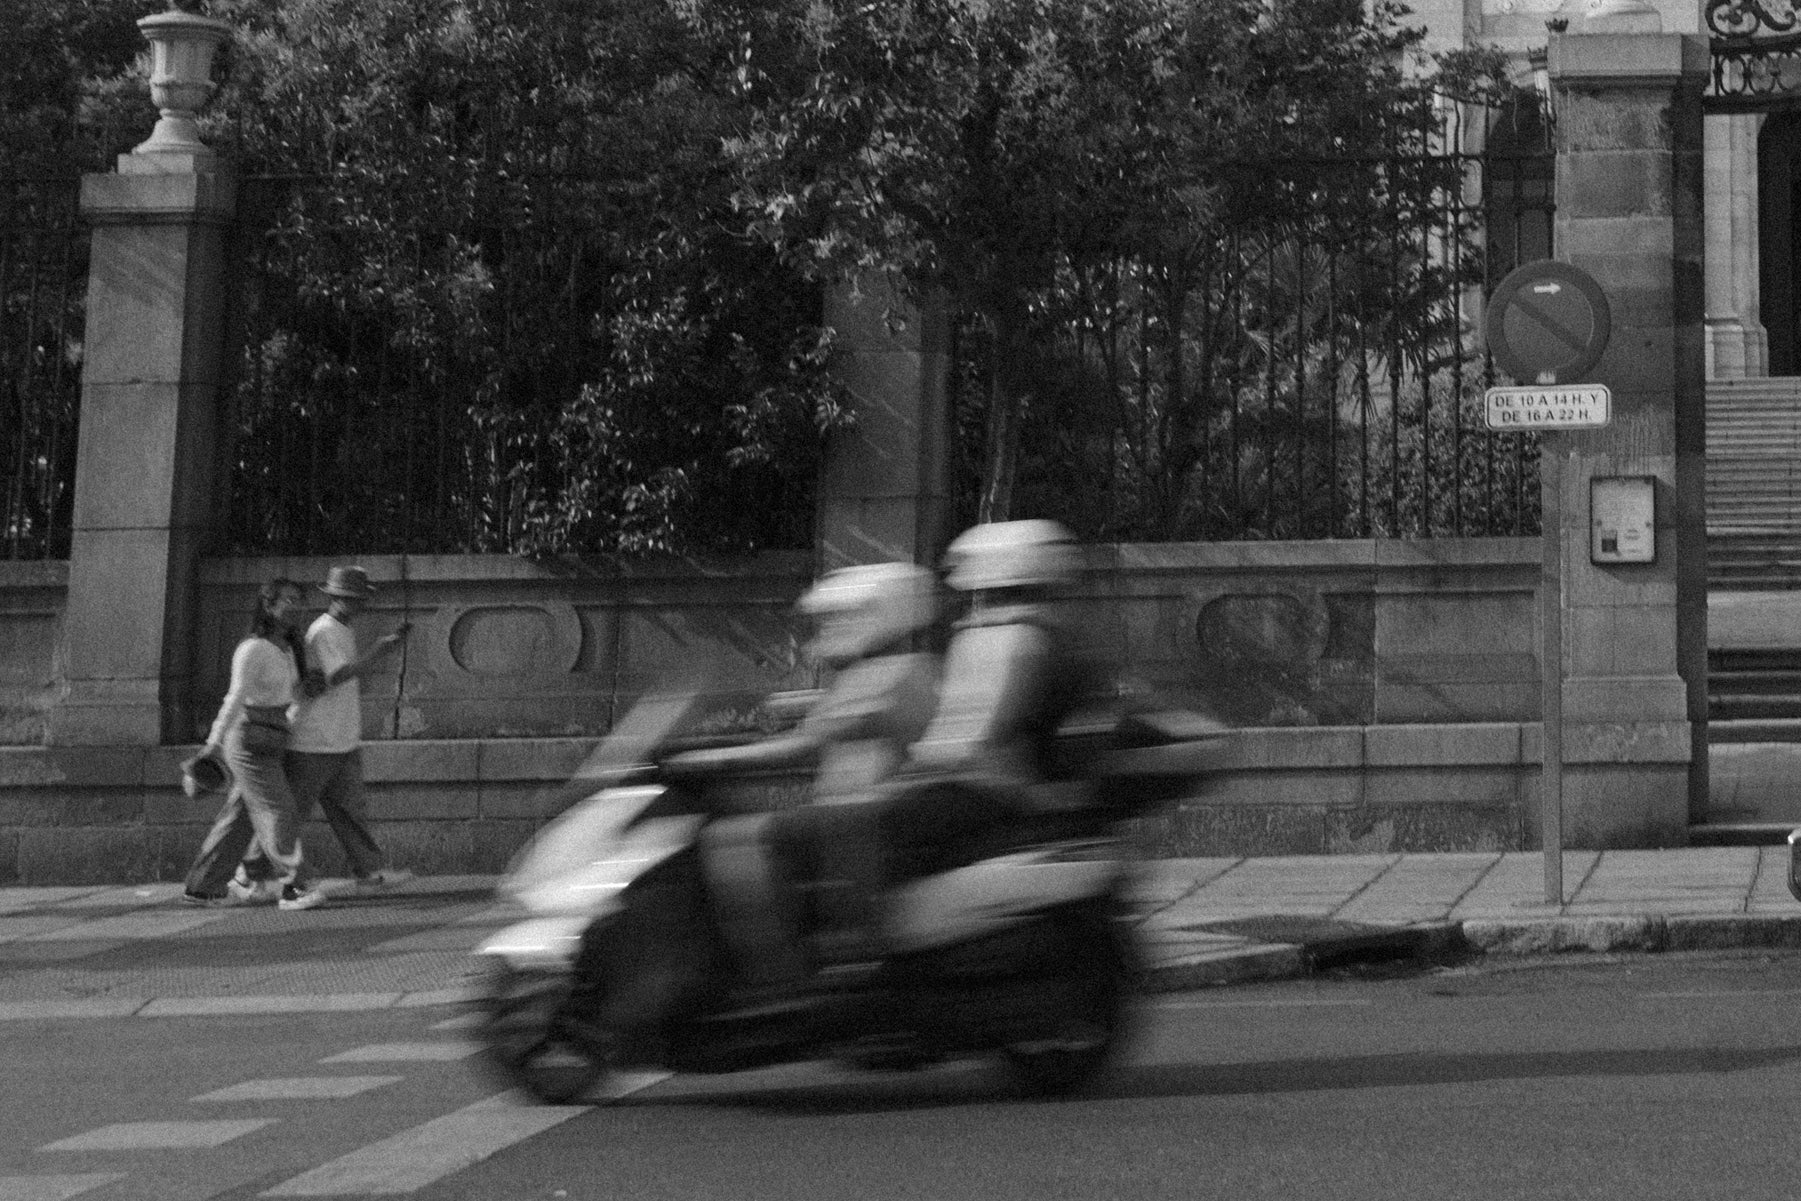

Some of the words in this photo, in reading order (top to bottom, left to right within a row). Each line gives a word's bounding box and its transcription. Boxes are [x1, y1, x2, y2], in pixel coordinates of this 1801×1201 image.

[1495, 395, 1514, 407] DE
[1521, 395, 1534, 407] 10
[1540, 393, 1549, 406] A
[1554, 394, 1567, 405] 14
[1590, 393, 1600, 404] Y
[1502, 410, 1520, 422] DE
[1527, 409, 1541, 422] 16
[1545, 408, 1555, 420] A
[1560, 408, 1575, 420] 22
